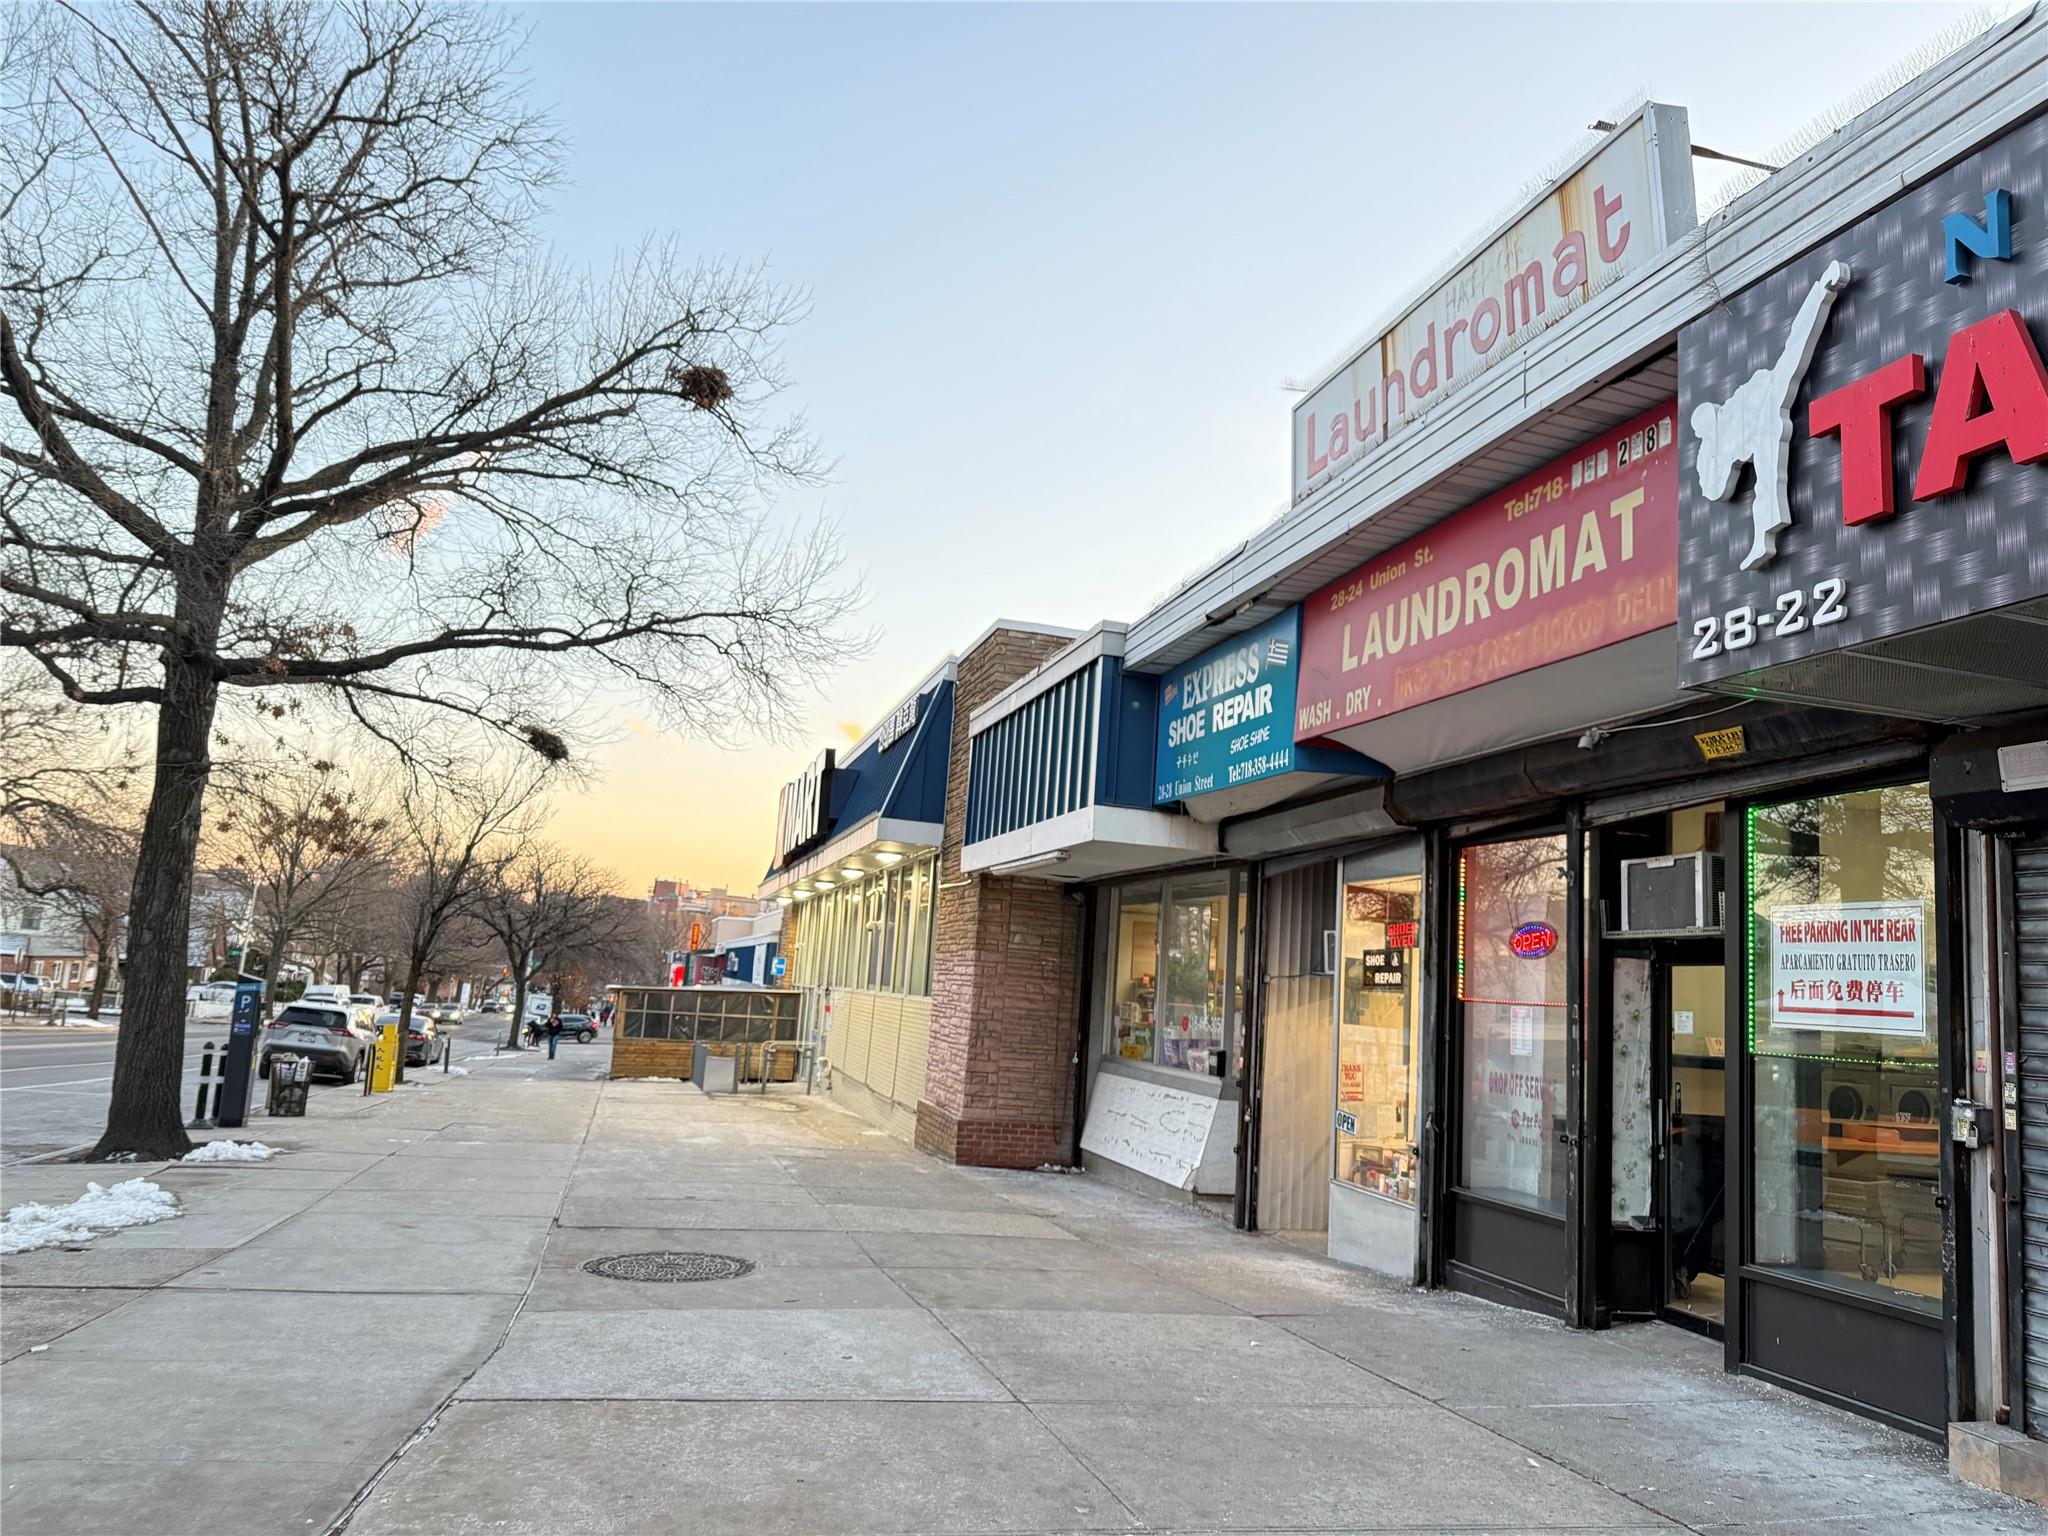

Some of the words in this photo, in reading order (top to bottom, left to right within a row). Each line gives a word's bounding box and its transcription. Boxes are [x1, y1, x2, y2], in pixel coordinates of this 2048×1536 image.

[1940, 187, 2012, 286] N
[1306, 184, 1631, 480] Laundromat
[1330, 580, 1363, 611] 28-24
[1370, 562, 1406, 590] Union
[1414, 546, 1434, 568] St.
[1342, 487, 1645, 673] LAUNDROMAT
[1692, 578, 1848, 660] 28-22
[1182, 643, 1260, 710] EXPRESS
[1168, 710, 1206, 747] SHOE
[1212, 683, 1273, 733] REPAIR
[1299, 699, 1331, 731] WASH
[1346, 685, 1371, 716] DRY
[1230, 733, 1249, 755] SHOE
[1250, 725, 1270, 746] SHINE
[1174, 779, 1192, 796] Union
[1194, 773, 1214, 792] Street
[1387, 922, 1418, 936] SHOES
[1390, 934, 1416, 949] DYED
[1513, 930, 1552, 951] OPEN
[1780, 921, 1803, 943] FREE
[1804, 919, 1848, 943] PARKING
[1850, 919, 1862, 943] IN
[1863, 919, 1884, 942] THE
[1886, 918, 1916, 942] REAR
[1365, 954, 1386, 967] SHOE
[1780, 953, 1835, 971] APARCAMIENTO
[1836, 953, 1876, 971] GRATUITO
[1878, 953, 1916, 972] TRASERO
[1374, 972, 1402, 985] REPAIR
[1790, 978, 1905, 1004] 后面免费停车
[240, 995, 252, 1009] P
[1489, 1071, 1508, 1094] DROP
[1509, 1073, 1524, 1096] OFF
[1337, 1111, 1356, 1132] OPEN
